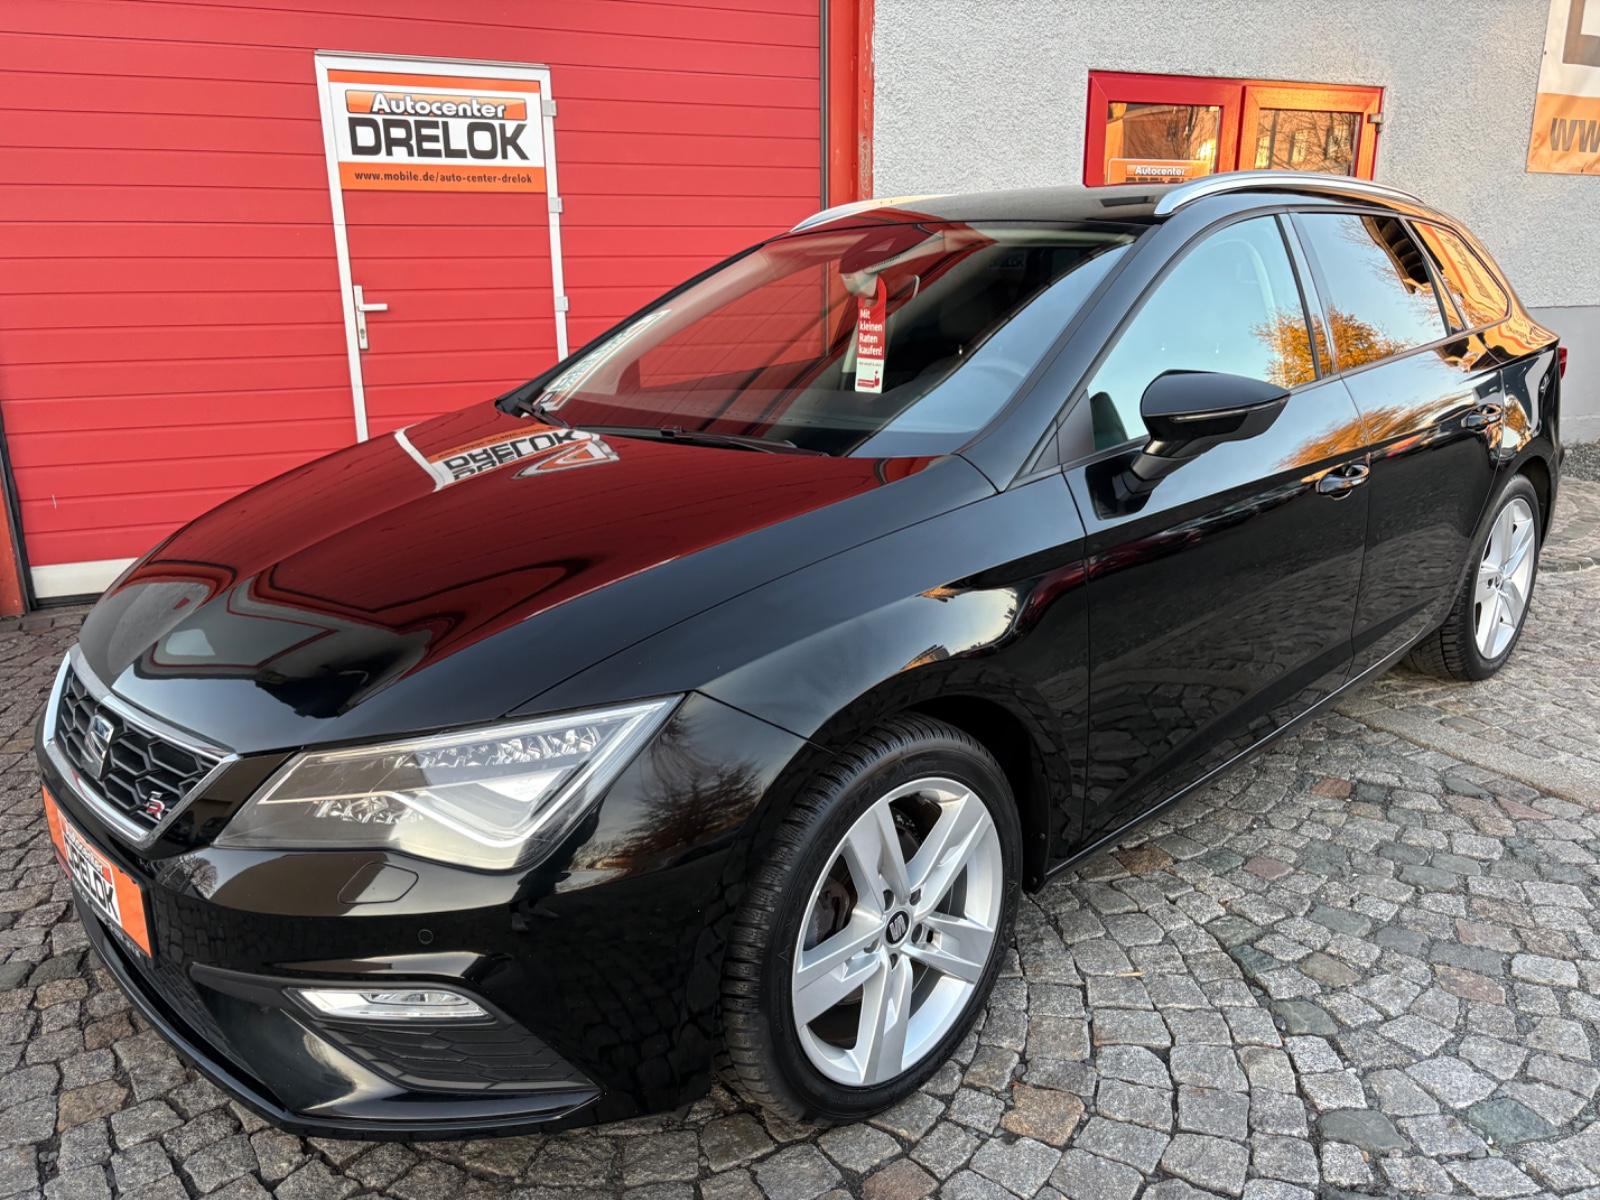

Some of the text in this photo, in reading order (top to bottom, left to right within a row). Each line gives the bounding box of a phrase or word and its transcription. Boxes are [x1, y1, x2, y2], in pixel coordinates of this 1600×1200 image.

[372, 93, 507, 118] Autocenter
[348, 117, 530, 160] DRELOK
[1135, 165, 1185, 176] Autocenter
[354, 171, 532, 183] www.mobile.de/auto-center-drelok
[860, 308, 871, 319] Mit
[860, 320, 883, 332] kleinen
[859, 333, 878, 344] Raten
[858, 344, 883, 356] kaufen!
